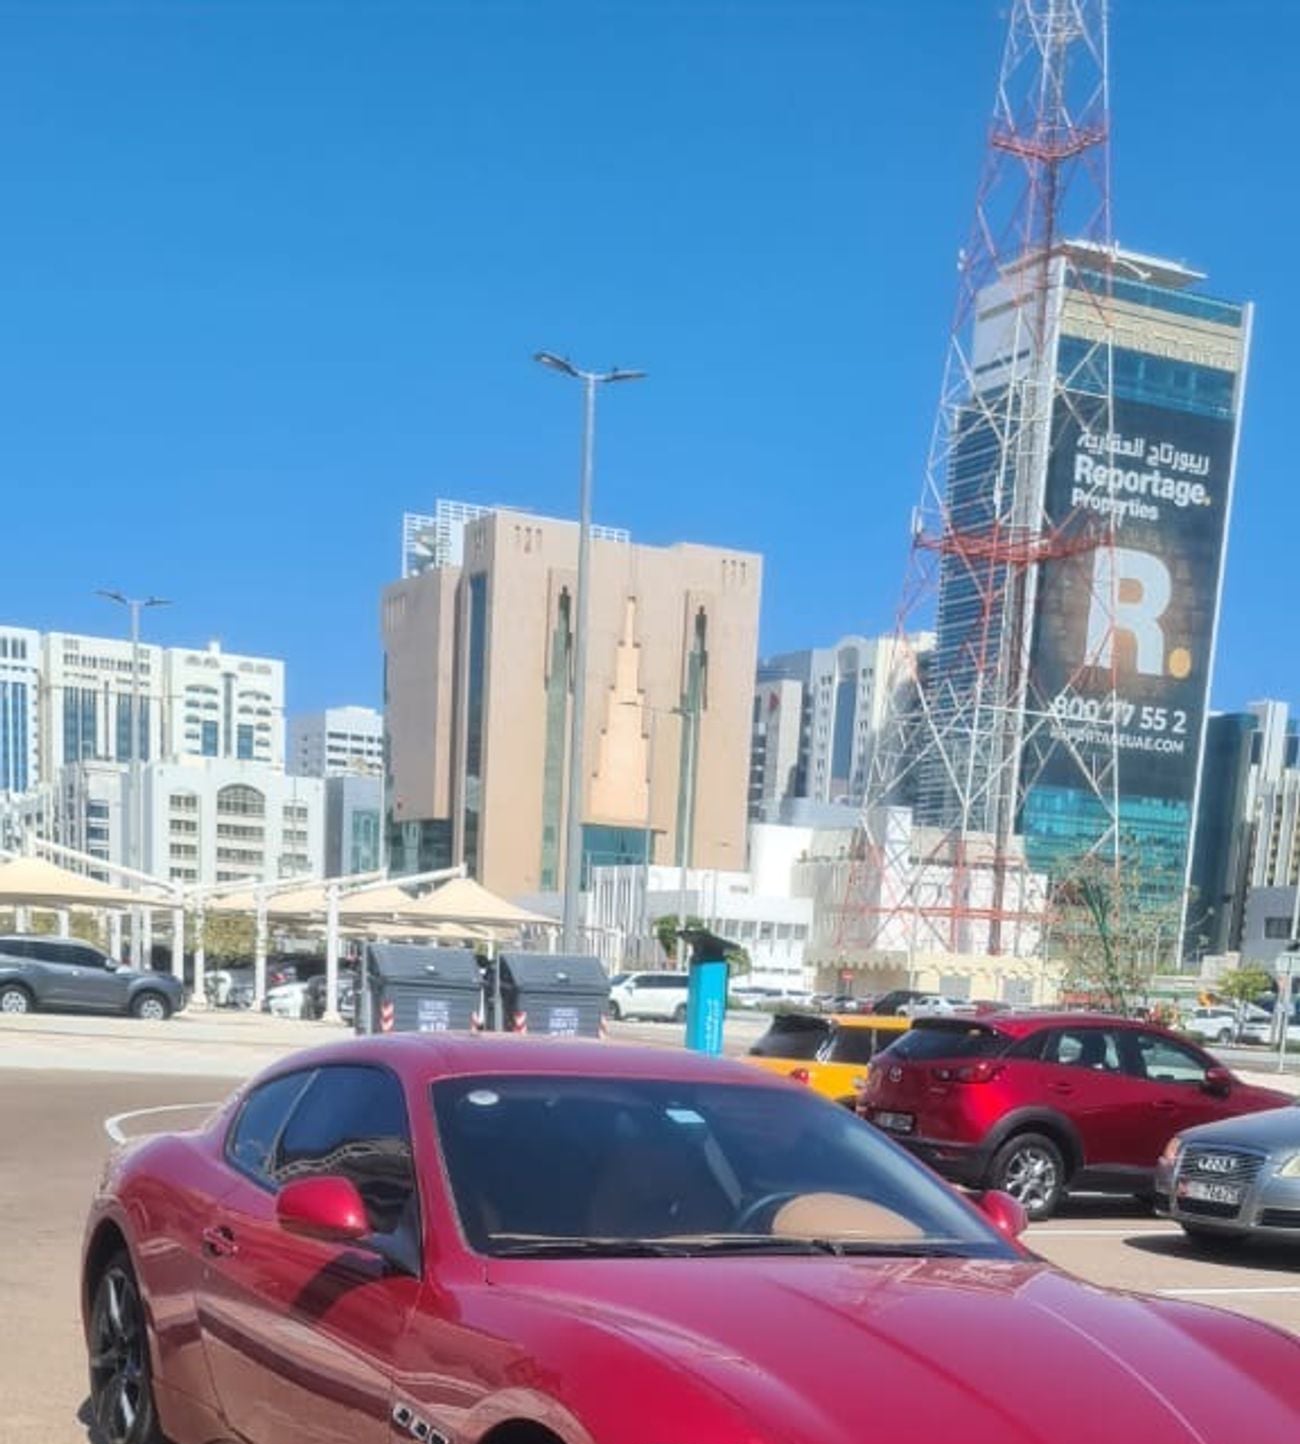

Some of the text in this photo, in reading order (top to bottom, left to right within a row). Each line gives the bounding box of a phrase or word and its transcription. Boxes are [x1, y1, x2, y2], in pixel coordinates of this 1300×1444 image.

[1071, 487, 1159, 521] Properties
[1054, 695, 1101, 720] 800
[1140, 706, 1169, 731] 55
[1172, 710, 1188, 735] 2
